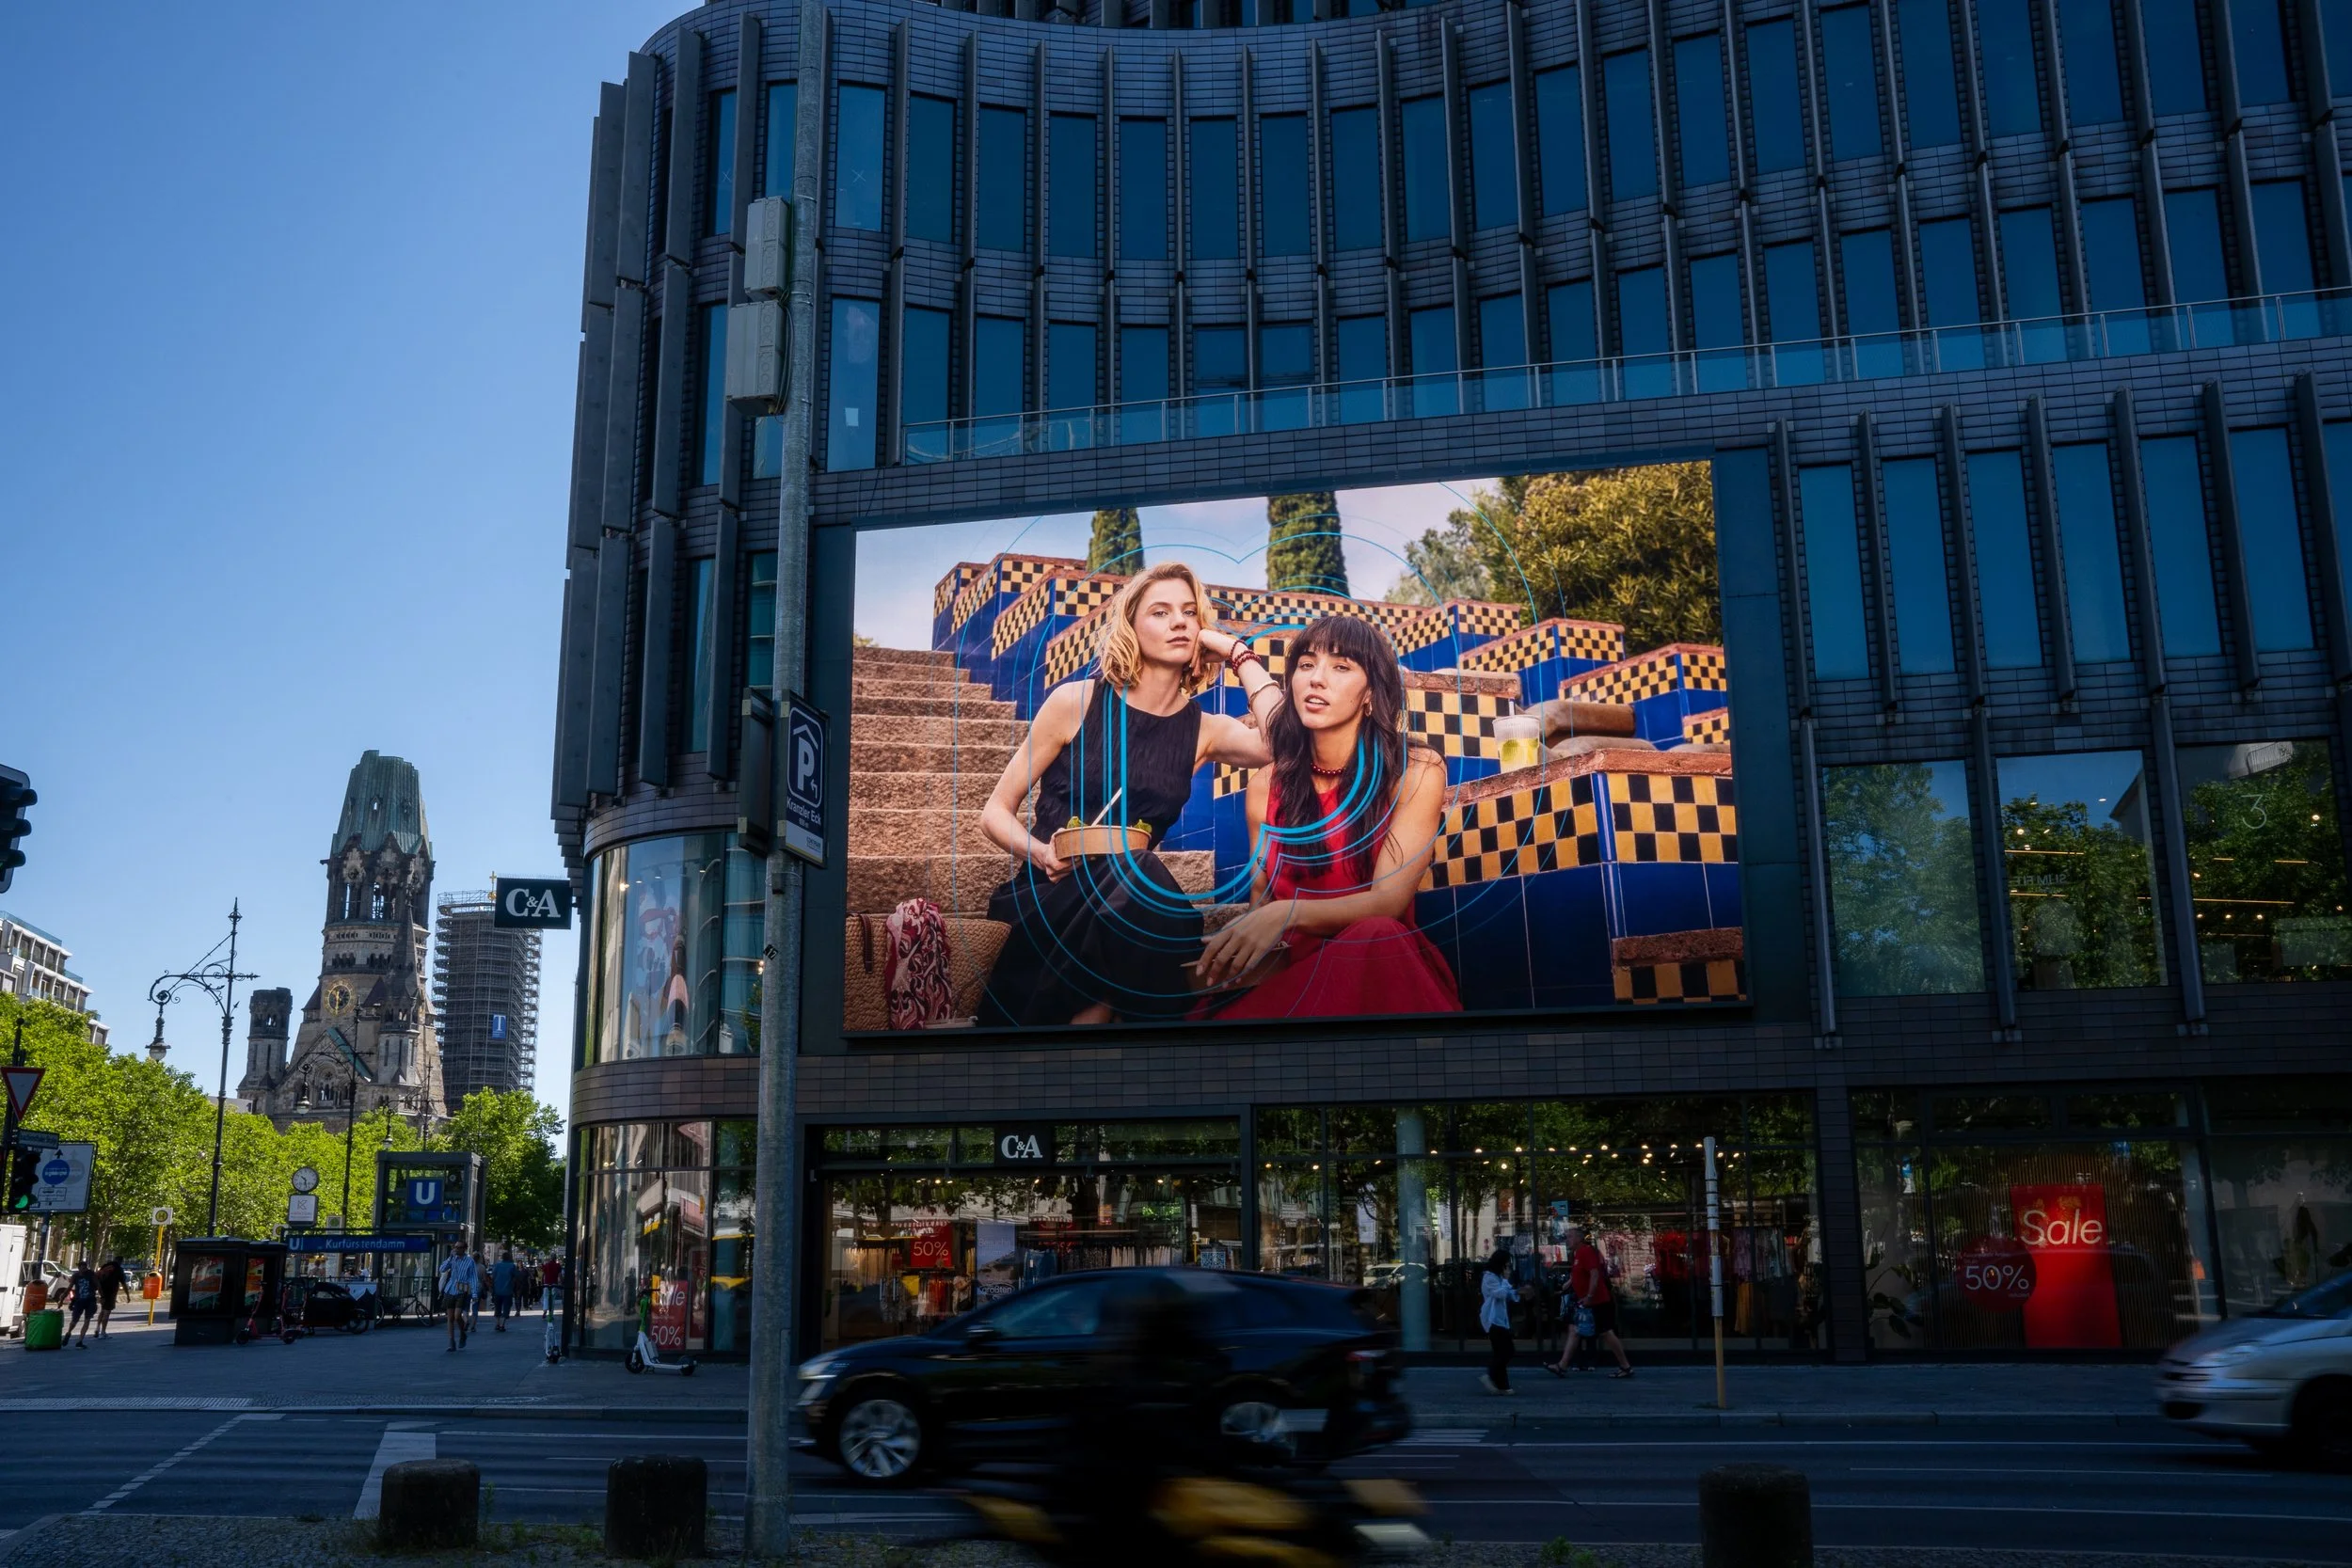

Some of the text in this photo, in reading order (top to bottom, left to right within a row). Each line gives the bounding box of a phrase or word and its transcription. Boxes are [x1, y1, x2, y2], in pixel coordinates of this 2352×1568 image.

[797, 736, 815, 791] P
[787, 798, 822, 826] Kranzler Eck
[2240, 794, 2267, 829] 3
[505, 888, 562, 918] C&A
[493, 1015, 506, 1031] T
[1001, 1134, 1043, 1159] C&A
[415, 1181, 436, 1205] U
[2021, 1208, 2103, 1246] Sale
[289, 1238, 300, 1250] U
[913, 1241, 949, 1257] 50%
[1964, 1264, 2029, 1291] 50%
[651, 1325, 681, 1346] 50%
